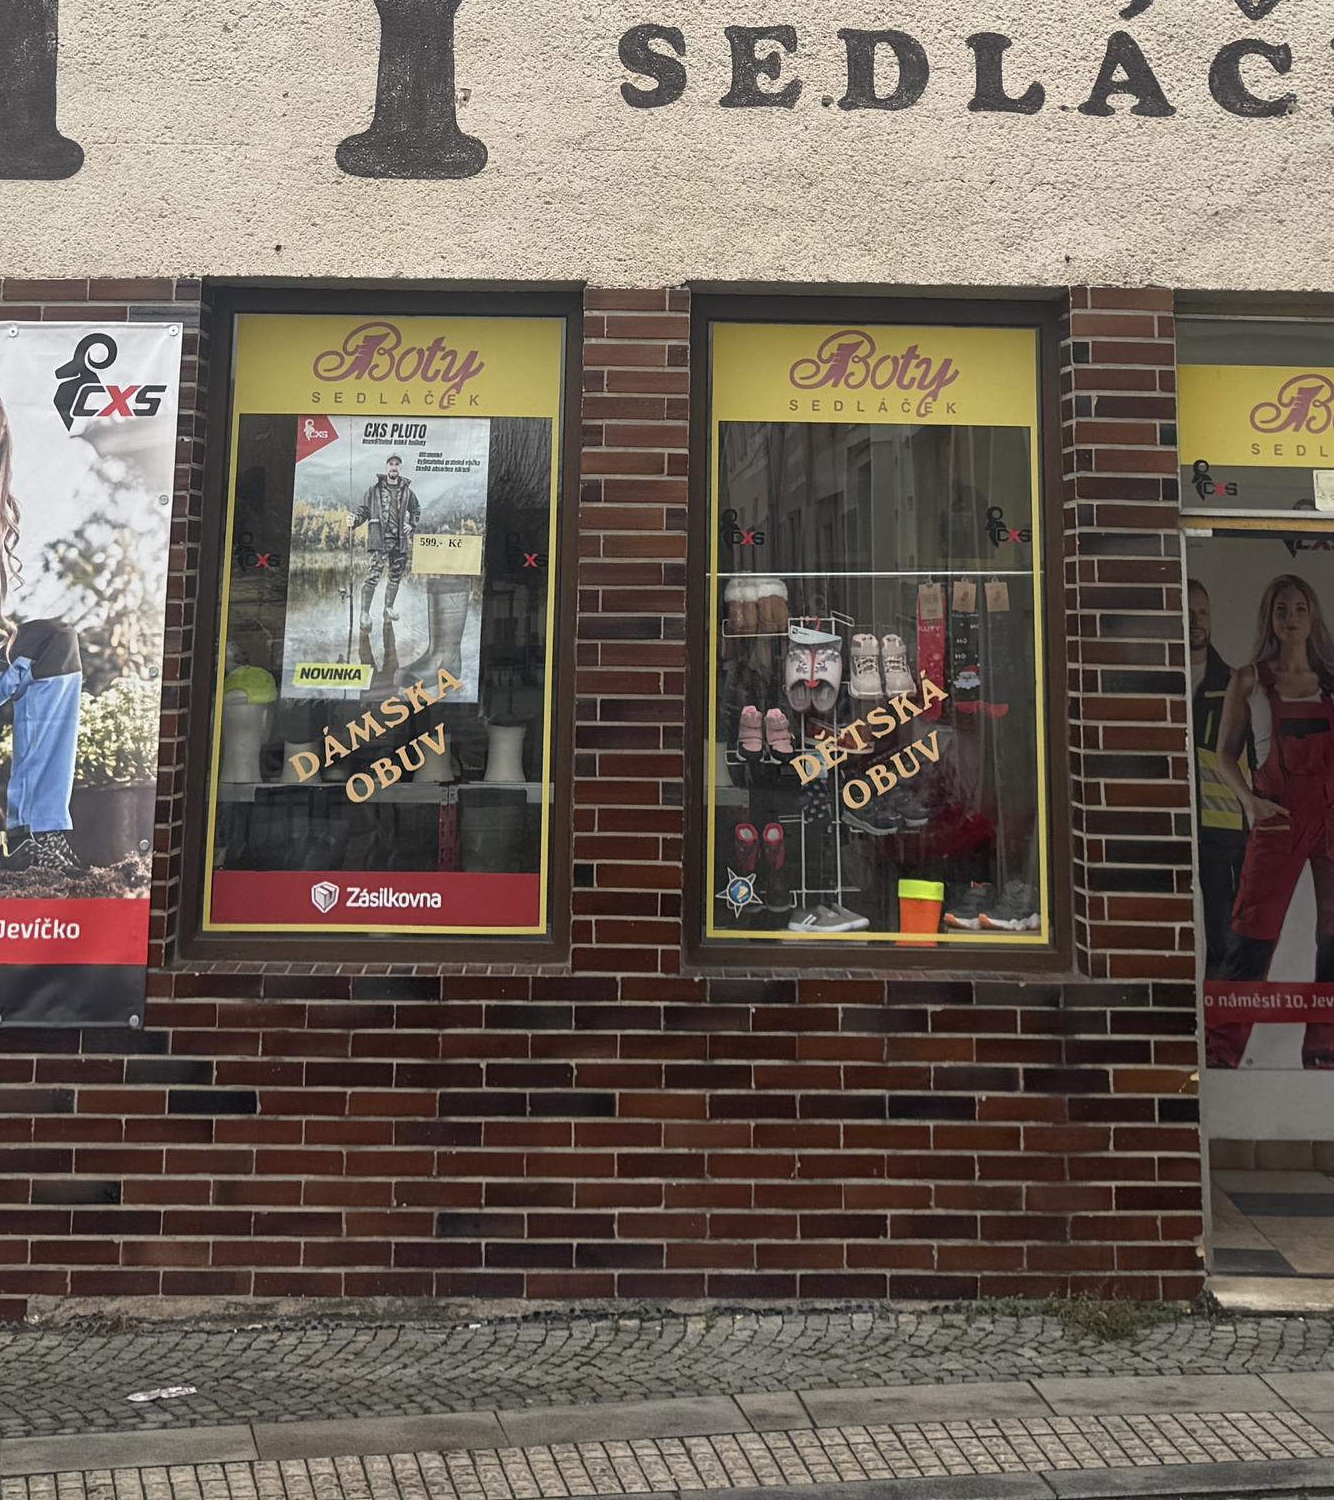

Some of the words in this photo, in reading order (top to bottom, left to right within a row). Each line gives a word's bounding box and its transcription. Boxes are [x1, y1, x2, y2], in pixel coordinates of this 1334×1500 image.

[313, 321, 485, 410] Boty
[789, 329, 959, 418] Boty
[72, 385, 167, 417] CXS
[311, 390, 480, 406] SEDLÁČEK
[788, 397, 957, 414] SEDLÁČEK
[364, 422, 388, 438] CXS
[390, 423, 427, 439] PLUTO
[1203, 482, 1238, 496] CXS
[419, 537, 443, 549] 599,-
[448, 537, 463, 548] Kč
[299, 667, 362, 681] NOVINKA
[288, 660, 463, 783] DÁMSKÁ
[790, 669, 949, 786] DĚTSKÁ
[345, 722, 447, 803] OBUV
[843, 730, 940, 810] OBUV
[346, 887, 442, 909] Zásilkovna
[1218, 992, 1282, 1008] náměstí
